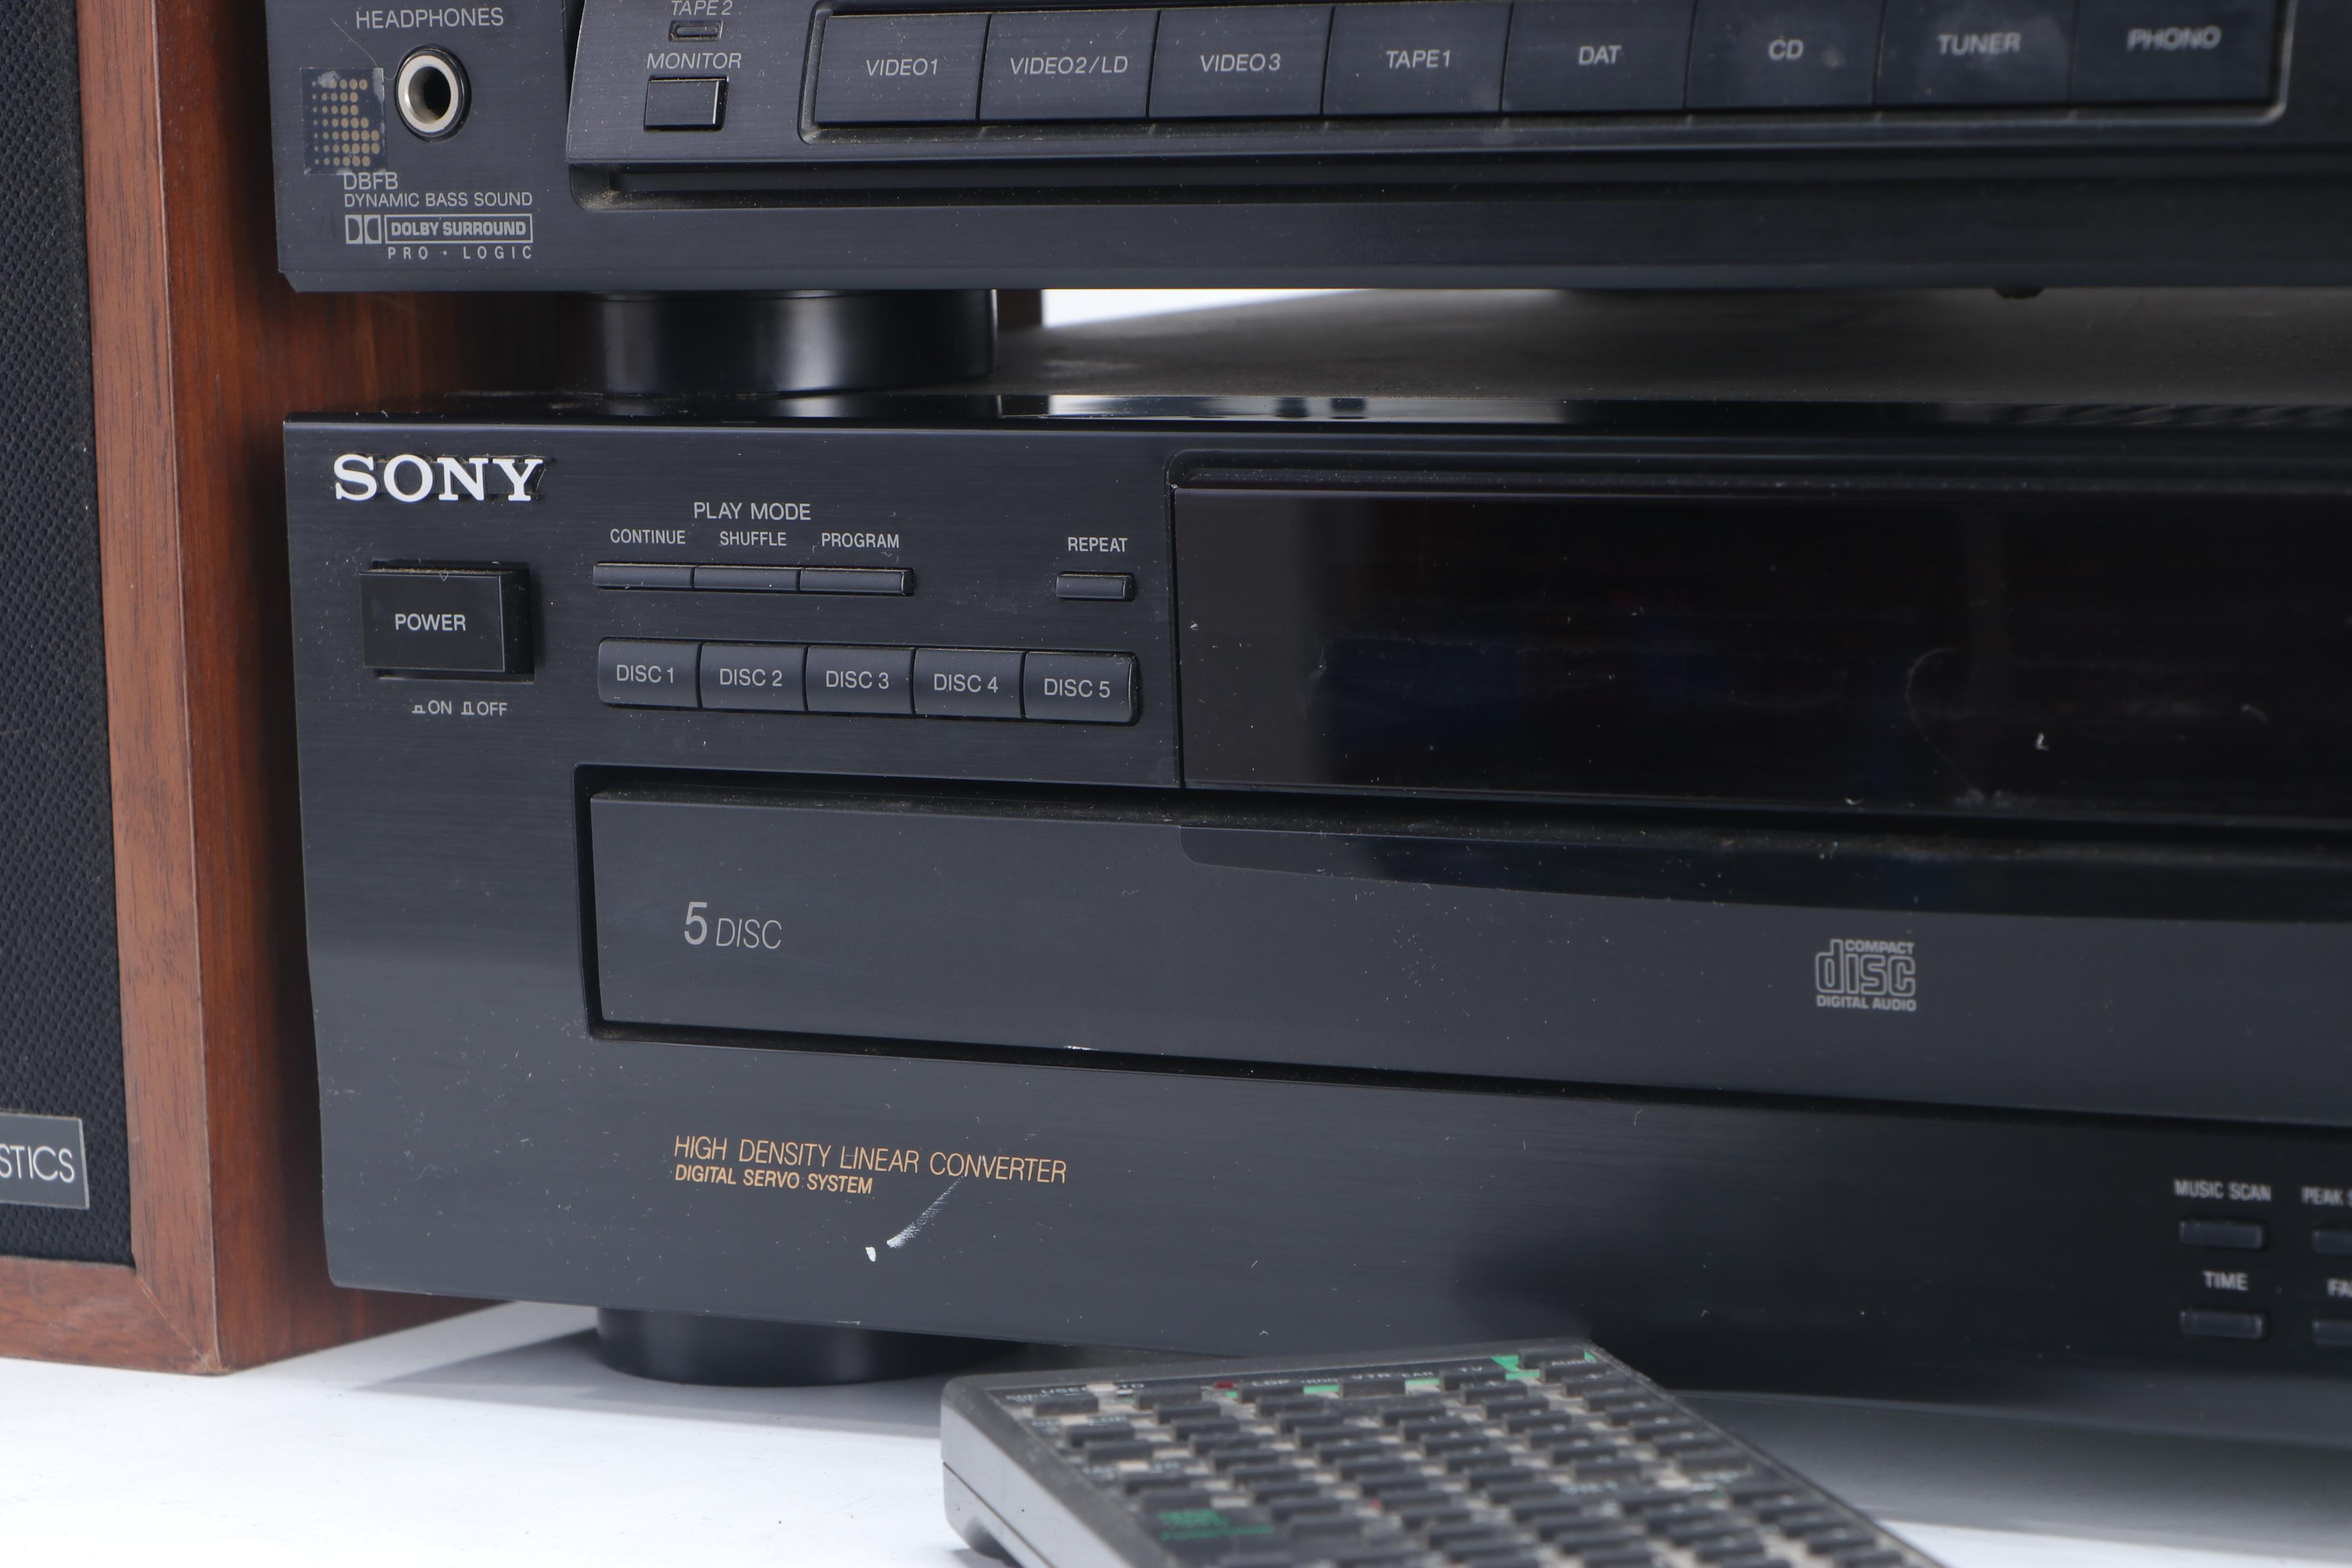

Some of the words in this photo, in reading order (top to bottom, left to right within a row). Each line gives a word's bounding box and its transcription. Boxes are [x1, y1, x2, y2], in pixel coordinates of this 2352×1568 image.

[355, 7, 504, 29] HEADPHONES
[671, 0, 719, 16] TAPE
[721, 0, 733, 15] 2
[1938, 32, 2021, 55] TUNER
[2126, 26, 2222, 51] PHONO
[1577, 44, 1622, 66] DAT
[1768, 38, 1804, 61] CD
[646, 52, 743, 70] MONITOR
[865, 57, 938, 77] VIDEO1
[1010, 55, 1129, 75] VIDEO2/LD
[342, 171, 398, 190] DBFB
[344, 192, 420, 208] DYNAMIC
[425, 192, 468, 207] BASS
[474, 192, 533, 207] SOUND
[391, 221, 439, 236] DOLBY
[443, 221, 526, 236] SURROUND
[387, 246, 429, 260] PRO
[462, 245, 533, 260] LOGIC
[334, 453, 544, 502] SONY
[694, 502, 742, 520] PLAY
[750, 502, 811, 521] MODE
[610, 528, 686, 545] CONTINUE
[719, 531, 787, 547] SHUFFLE
[821, 533, 900, 549] PROGRAM
[1067, 537, 1128, 553] REPEAT
[394, 613, 466, 632] POWER
[616, 664, 662, 683] DISC
[667, 667, 674, 684] 1
[720, 668, 766, 687] DISC
[772, 669, 783, 687] 2
[826, 670, 873, 689] DISC
[877, 672, 890, 690] 3
[934, 674, 982, 693] DISC
[986, 676, 999, 693] 4
[1044, 678, 1093, 698] DISC
[1099, 681, 1110, 698] 5
[427, 700, 452, 715] ON
[476, 701, 508, 716] OFF
[684, 901, 708, 945] 5
[716, 917, 782, 949] DISC
[1844, 939, 1915, 955] COMPACT
[1814, 938, 1916, 997] disc
[1816, 995, 1869, 1009] DIGITAL
[1872, 997, 1917, 1012] AUDIO
[674, 1135, 728, 1160] HIGH
[738, 1138, 832, 1167] DENSITY
[839, 1145, 920, 1173] LINEAR
[929, 1151, 1068, 1183] CONVERTER
[674, 1163, 737, 1185] DIGITAL
[742, 1168, 801, 1189] SERVO
[805, 1172, 874, 1194] SYSTEM
[2174, 1179, 2224, 1199] MUSIC
[2228, 1182, 2272, 1202] SCAN
[2302, 1186, 2344, 1206] PEAK
[2203, 1270, 2248, 1291] TIME
